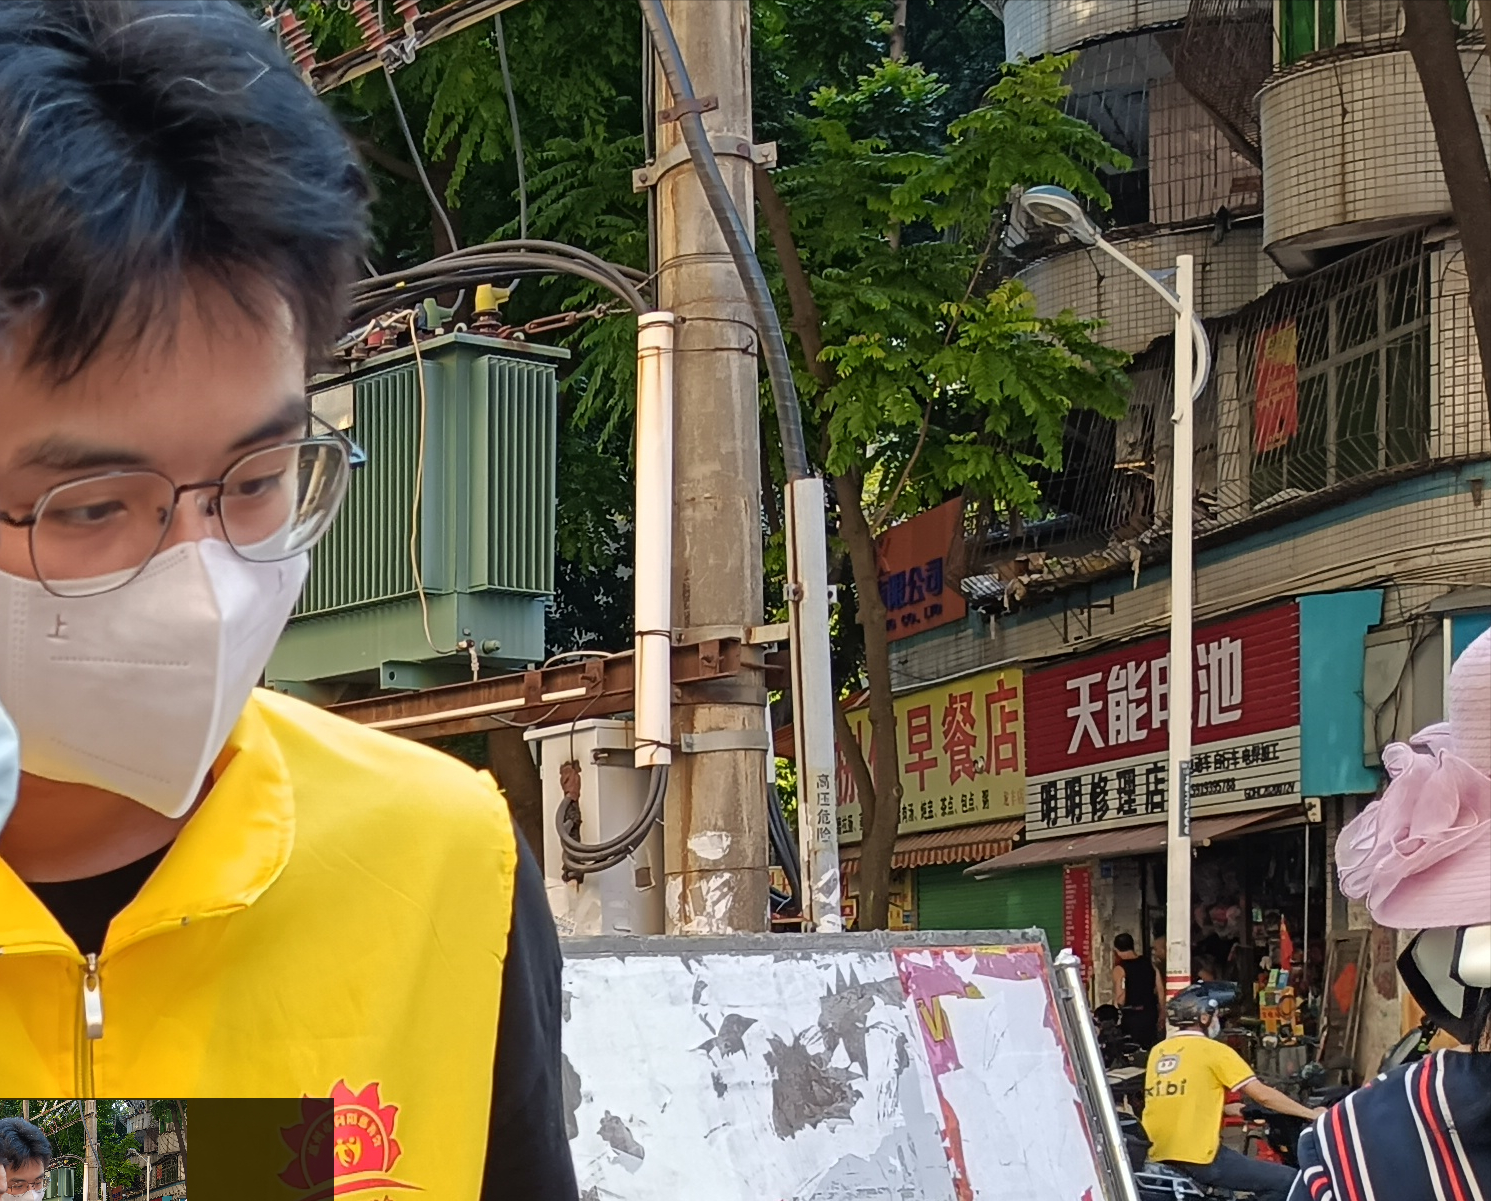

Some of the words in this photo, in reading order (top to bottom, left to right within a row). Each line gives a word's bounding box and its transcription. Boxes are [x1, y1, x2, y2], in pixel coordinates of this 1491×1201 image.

[46, 613, 69, 639] 上
[816, 773, 832, 843] 高压危险
[1040, 761, 1167, 828] 明明修理店
